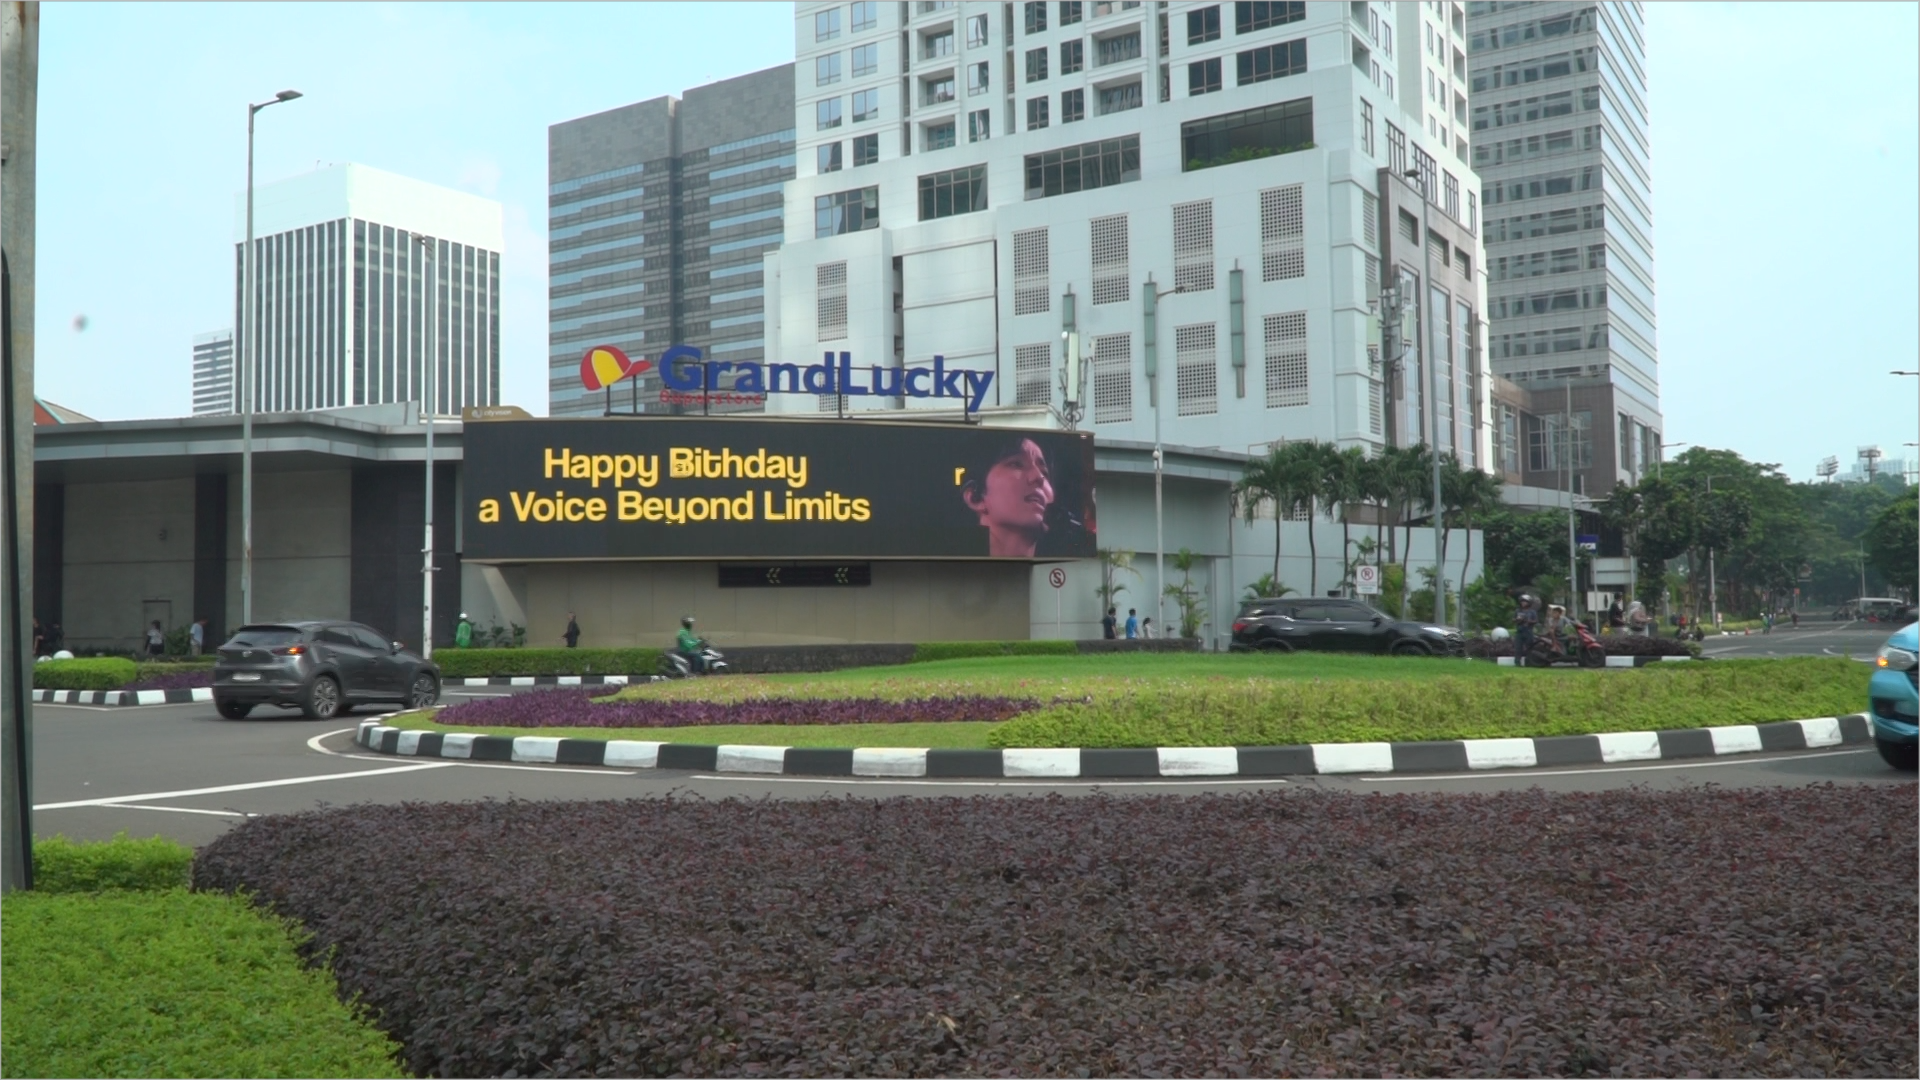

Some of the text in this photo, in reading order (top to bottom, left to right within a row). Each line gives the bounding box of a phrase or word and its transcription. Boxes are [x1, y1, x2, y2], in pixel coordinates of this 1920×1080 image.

[659, 345, 994, 412] GrandLucky
[660, 390, 763, 406] Superstore
[543, 447, 808, 488] Happy Bithday
[478, 490, 872, 525] a Voice Beyond Limits
